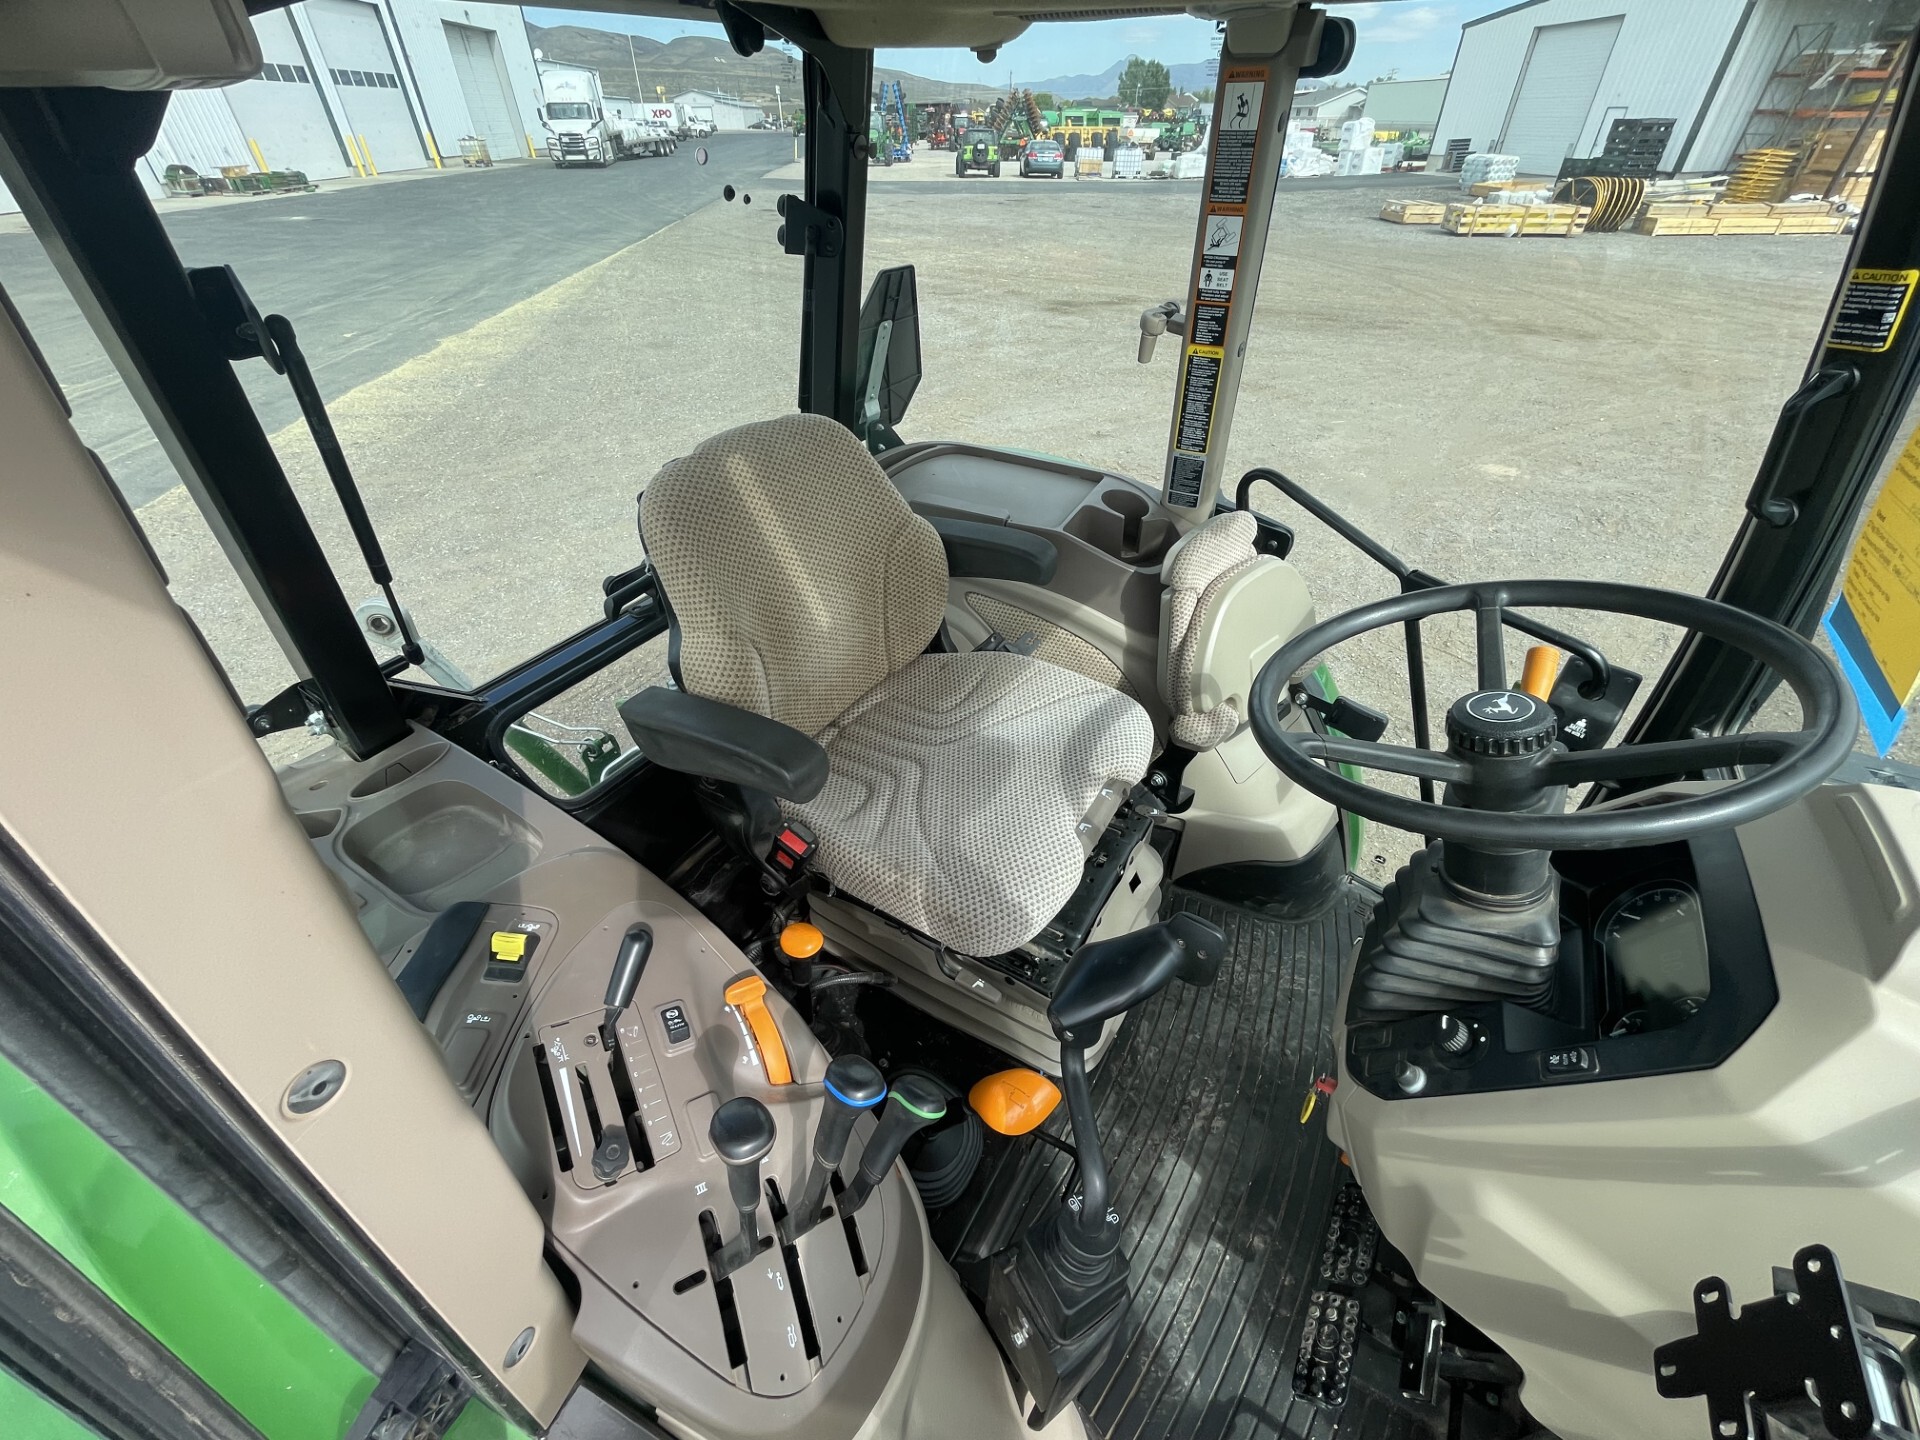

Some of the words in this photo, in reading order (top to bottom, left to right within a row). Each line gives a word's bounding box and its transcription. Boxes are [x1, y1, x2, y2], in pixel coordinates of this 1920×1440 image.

[1235, 70, 1265, 78] WARNING
[651, 109, 672, 118] XPO
[1216, 205, 1244, 213] WARNING
[1861, 272, 1908, 281] CAUTION
